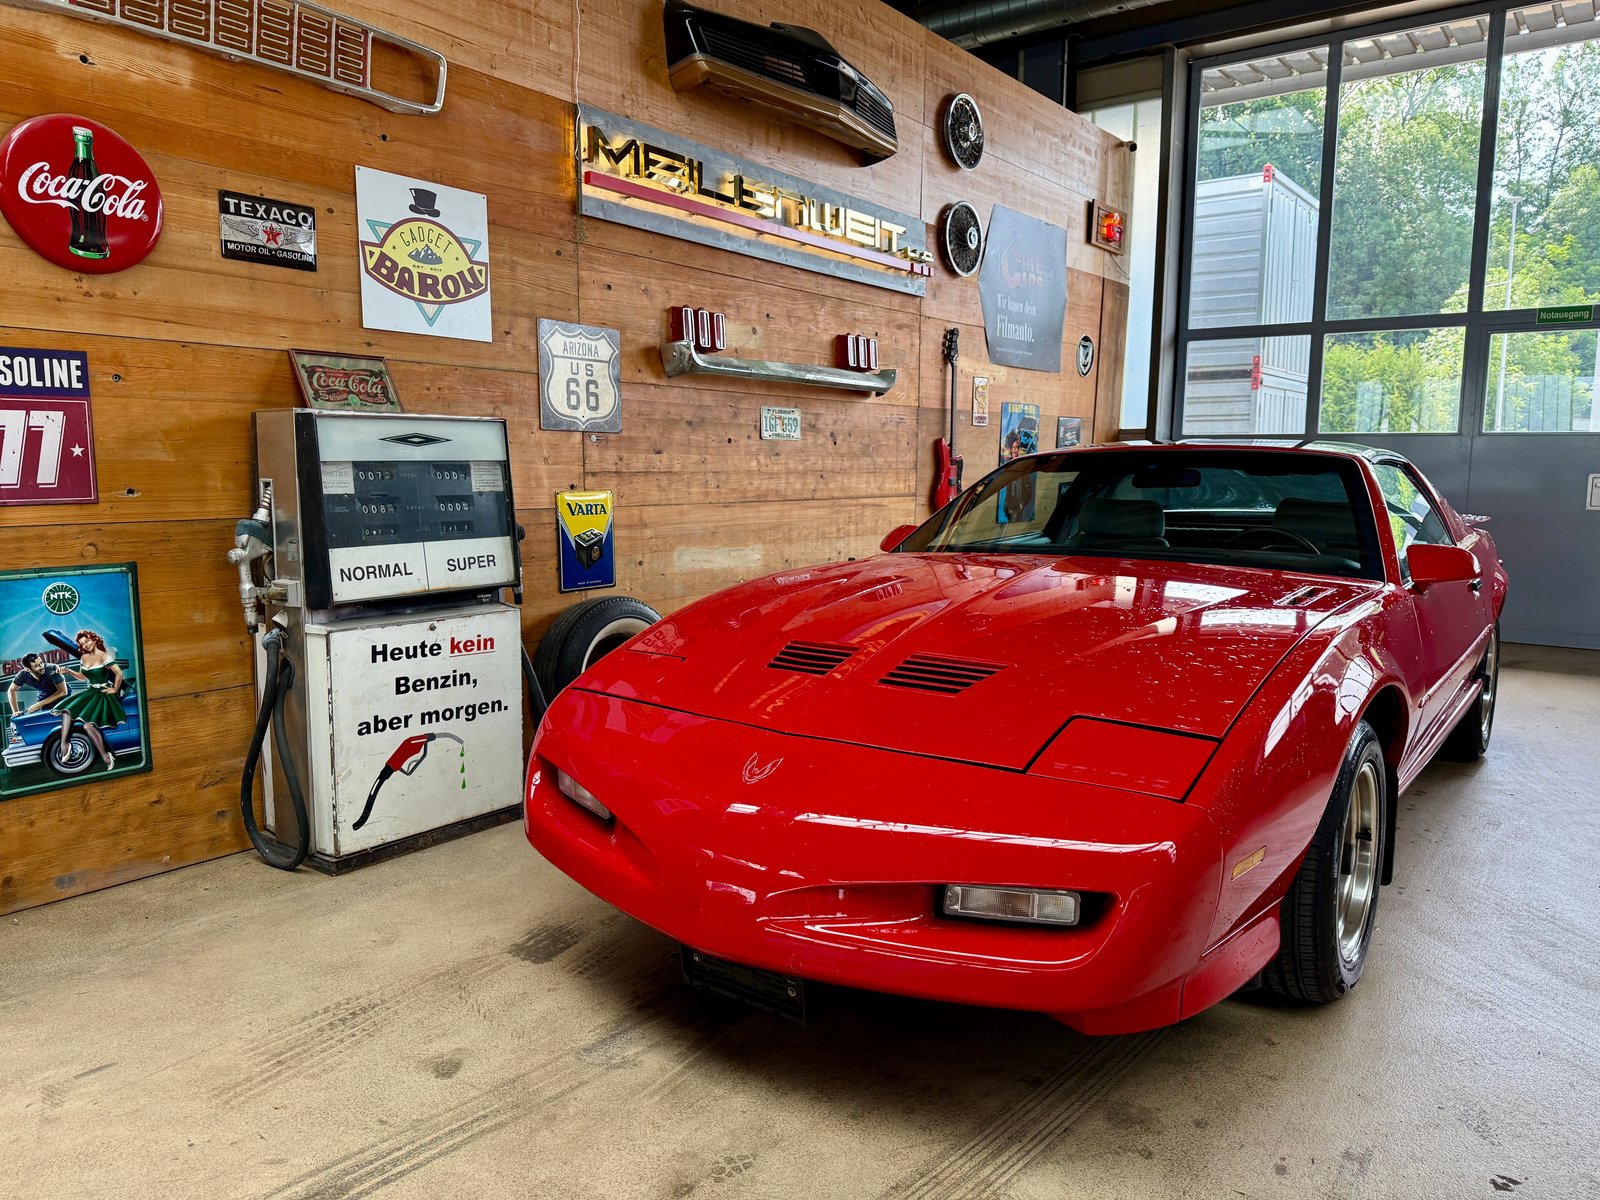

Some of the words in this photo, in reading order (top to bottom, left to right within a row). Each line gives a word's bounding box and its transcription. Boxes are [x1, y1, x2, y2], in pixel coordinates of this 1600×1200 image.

[18, 161, 148, 221] Coca-Cola
[224, 197, 312, 227] TEXACO
[227, 242, 257, 253] MOTOR
[258, 247, 271, 256] OIL
[400, 226, 452, 253] GADGET
[371, 250, 484, 299] BARON
[1540, 310, 1590, 320] Notausgang
[996, 314, 1035, 343] Filmauto.
[562, 340, 600, 357] ARIZONA
[565, 377, 600, 411] 66
[567, 501, 608, 517] VARTA
[340, 561, 414, 583] NORMAL
[446, 553, 497, 573] SUPER
[50, 591, 72, 600] NTK
[371, 640, 442, 664] Heute
[449, 634, 495, 655] kein
[395, 669, 478, 695] Benzin,
[357, 712, 413, 737] aber
[420, 699, 509, 725] morgen.
